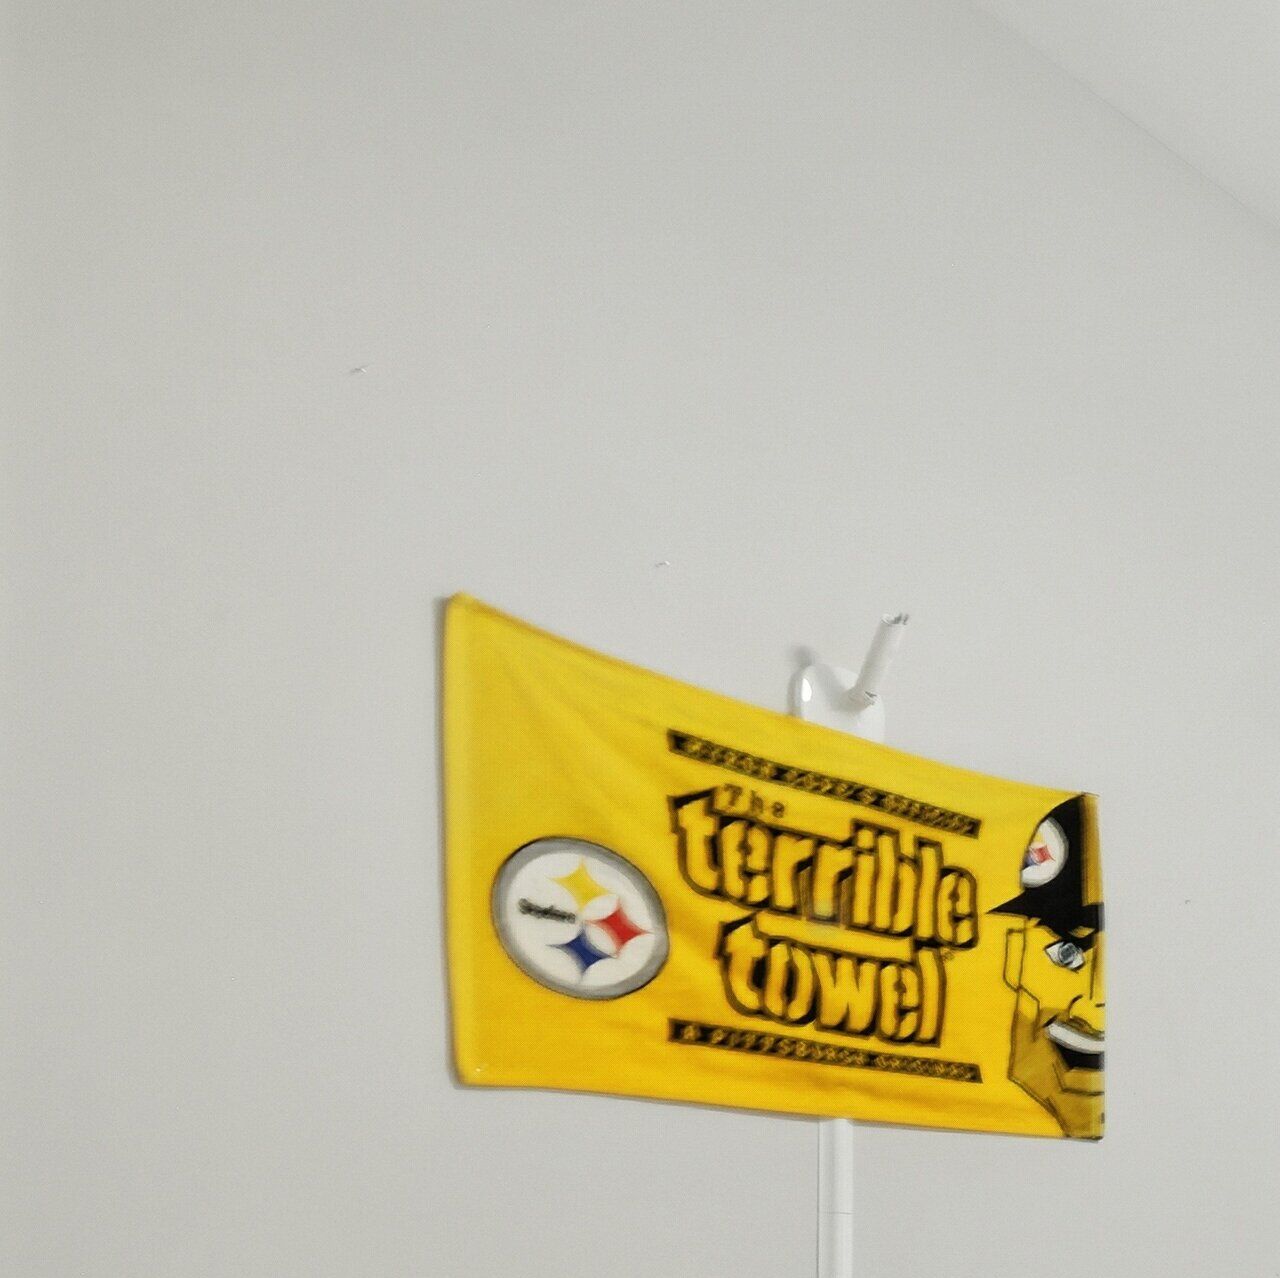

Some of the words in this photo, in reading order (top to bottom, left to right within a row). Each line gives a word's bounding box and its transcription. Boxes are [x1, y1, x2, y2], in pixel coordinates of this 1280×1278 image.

[667, 787, 979, 950] terrible
[721, 783, 786, 819] The
[716, 912, 947, 1047] towel
